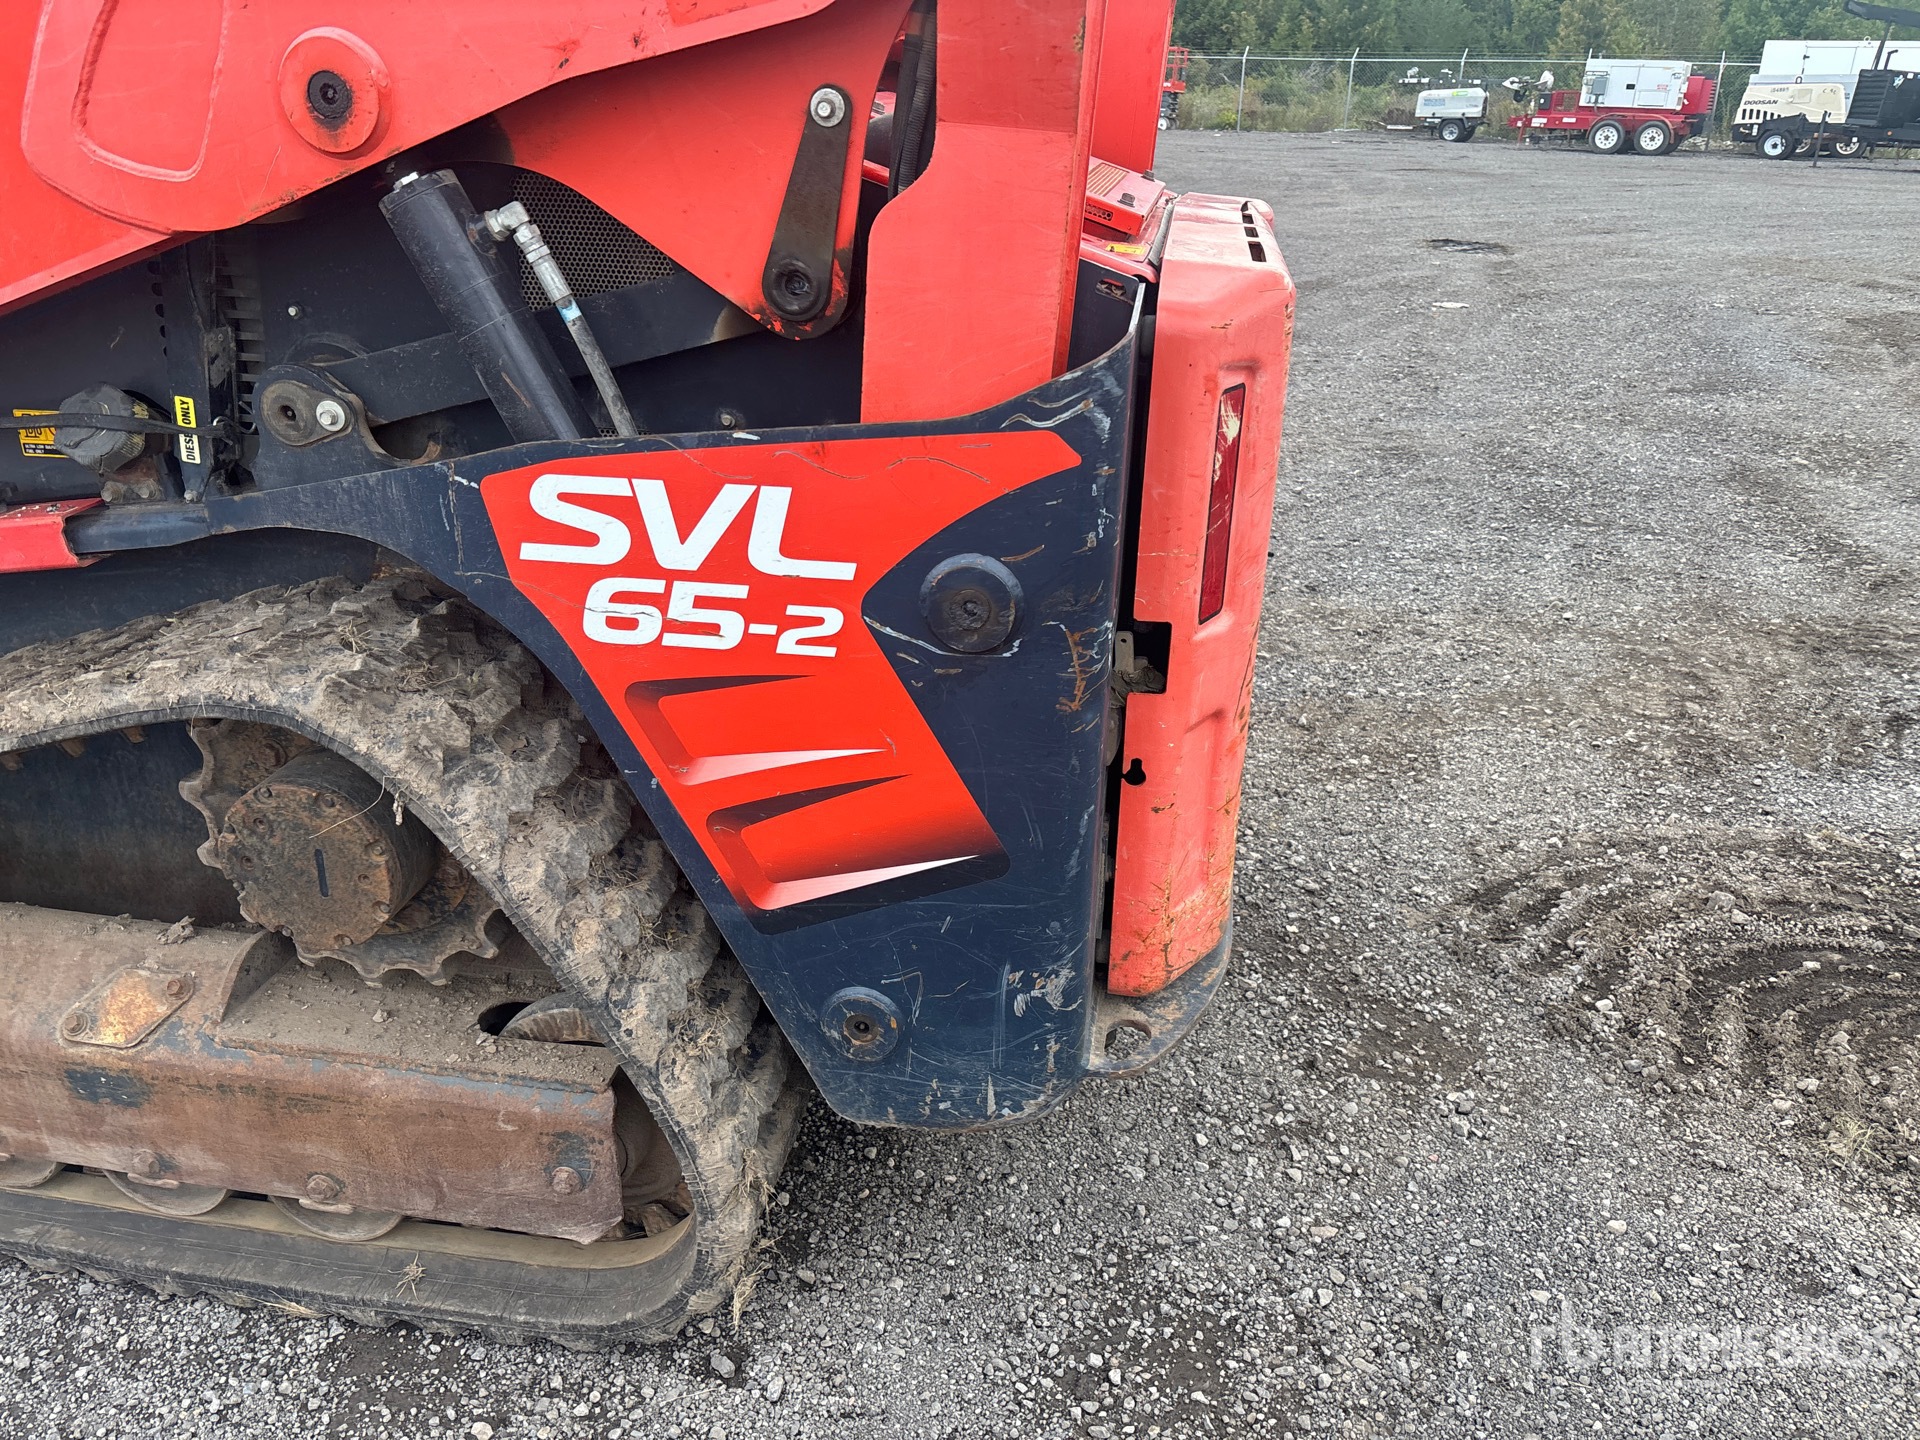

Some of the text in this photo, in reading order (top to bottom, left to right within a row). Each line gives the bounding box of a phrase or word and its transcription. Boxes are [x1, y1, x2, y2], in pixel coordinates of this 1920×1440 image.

[179, 399, 196, 461] DIESE ONLY
[519, 473, 858, 581] SVL
[582, 577, 845, 658] 65-2
